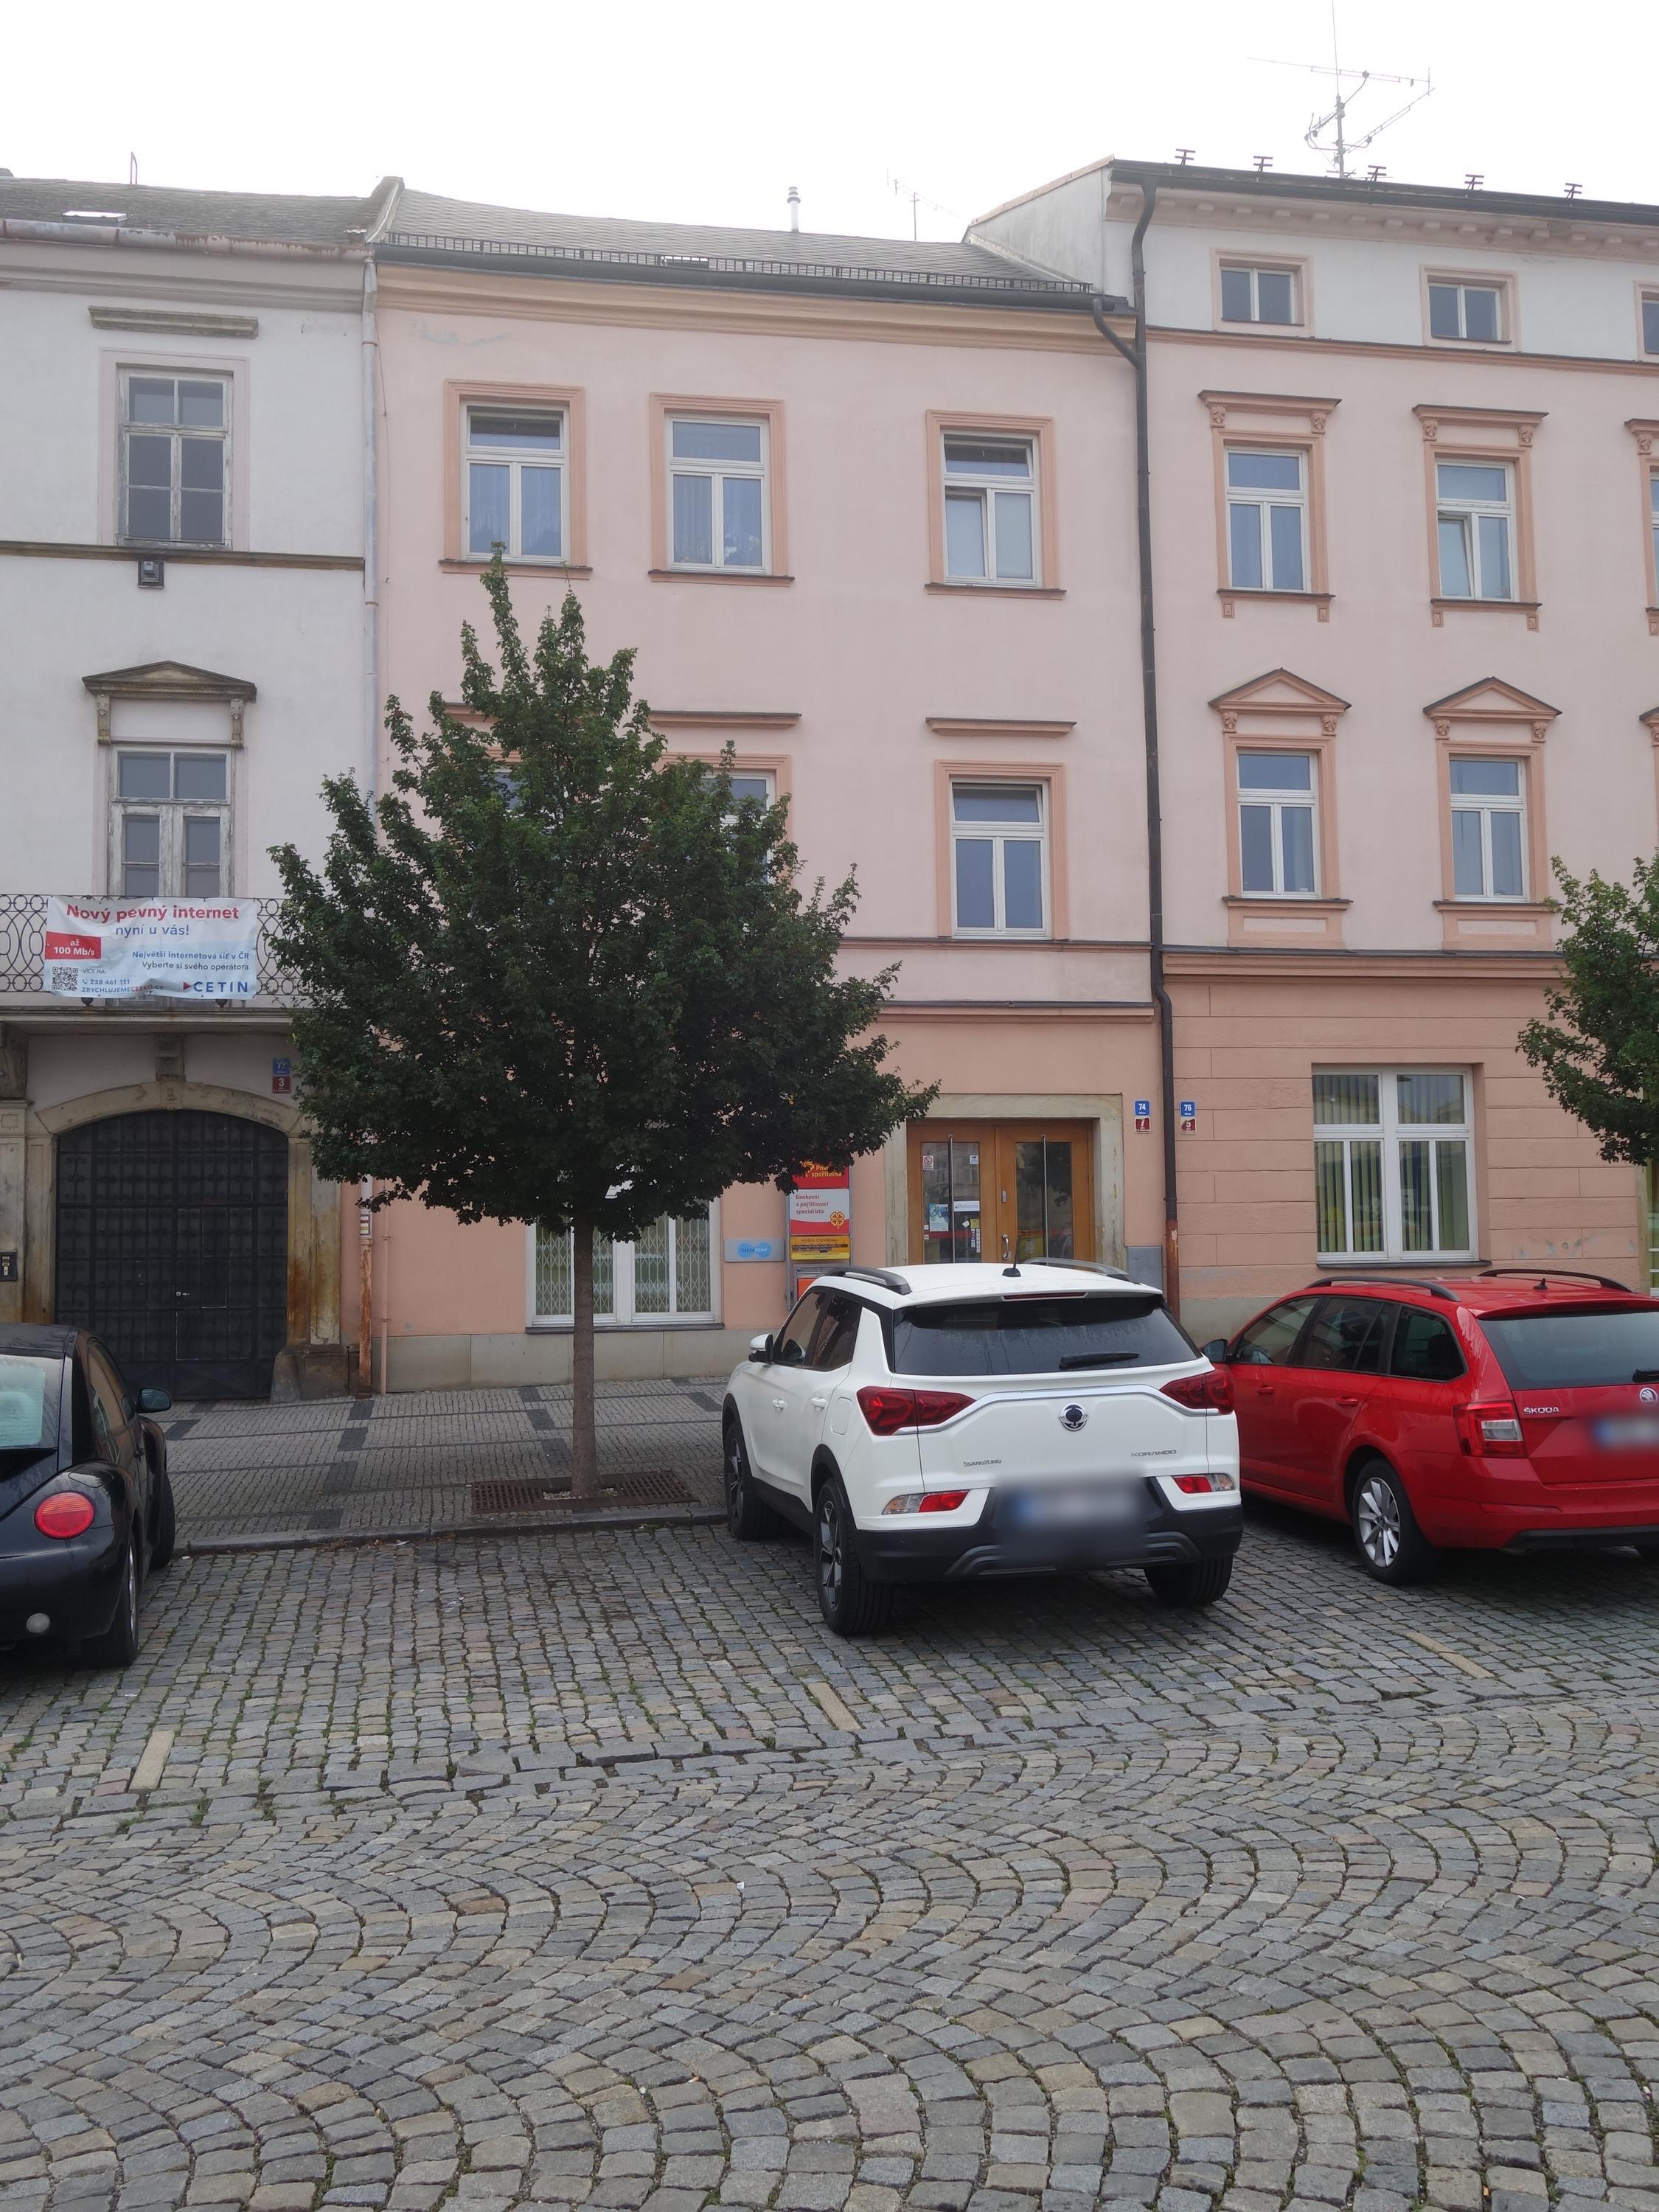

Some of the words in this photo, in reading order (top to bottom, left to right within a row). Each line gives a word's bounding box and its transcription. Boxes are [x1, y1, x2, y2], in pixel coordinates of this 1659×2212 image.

[66, 904, 111, 924] Nový
[116, 905, 167, 922] pevný
[173, 905, 239, 919] internet
[116, 924, 145, 938] nyní
[150, 927, 156, 935] u
[162, 924, 189, 936] vás!
[54, 947, 71, 955] 100
[74, 947, 95, 956] Mb/s
[132, 950, 166, 959] Největší
[168, 951, 217, 959] internetová
[142, 961, 174, 970] Vyberte
[184, 961, 209, 970] svého
[210, 962, 249, 972] operátora
[193, 981, 248, 993] CETIN
[278, 1077, 285, 1087] 3
[1523, 1406, 1560, 1414] ŠKODA
[1130, 1449, 1177, 1457] KORANDO
